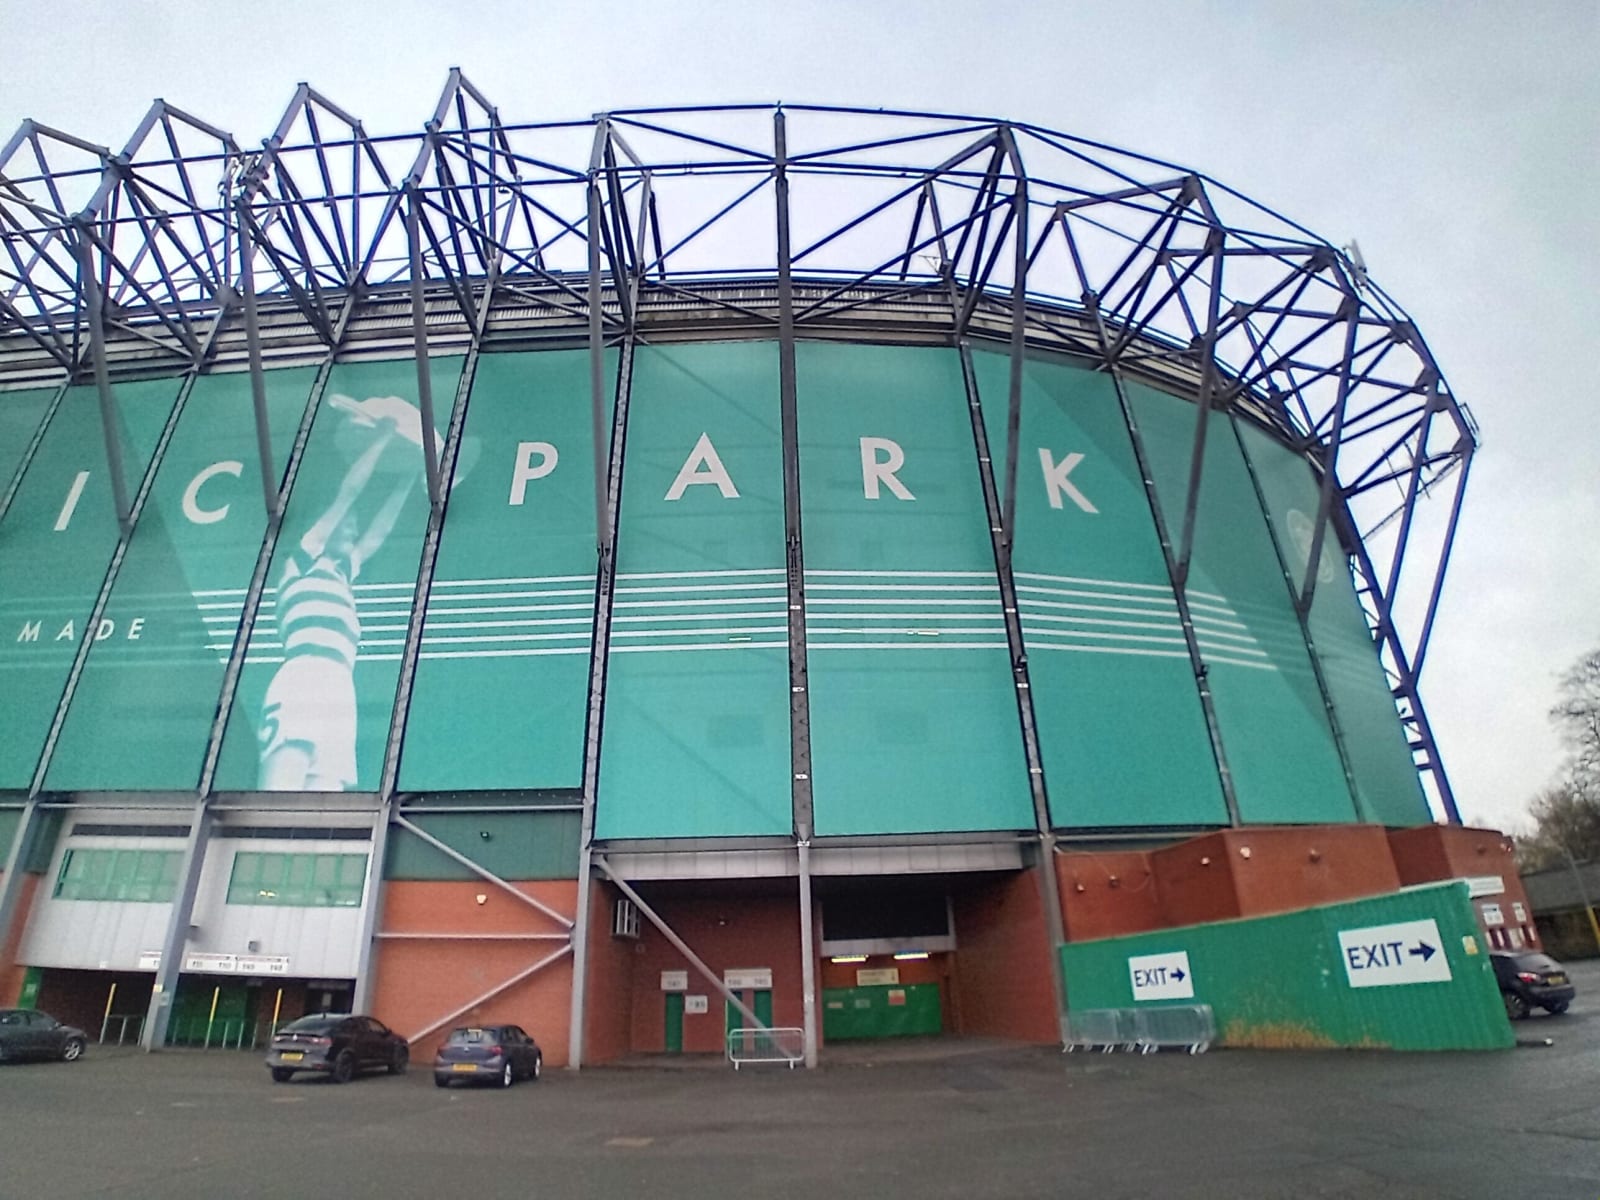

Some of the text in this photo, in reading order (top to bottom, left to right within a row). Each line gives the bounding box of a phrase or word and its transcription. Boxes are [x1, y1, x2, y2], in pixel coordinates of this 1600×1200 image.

[509, 432, 1100, 514] PARK
[17, 618, 145, 642] MADE
[1346, 942, 1403, 970] EXIT
[1133, 967, 1167, 988] EXIT
